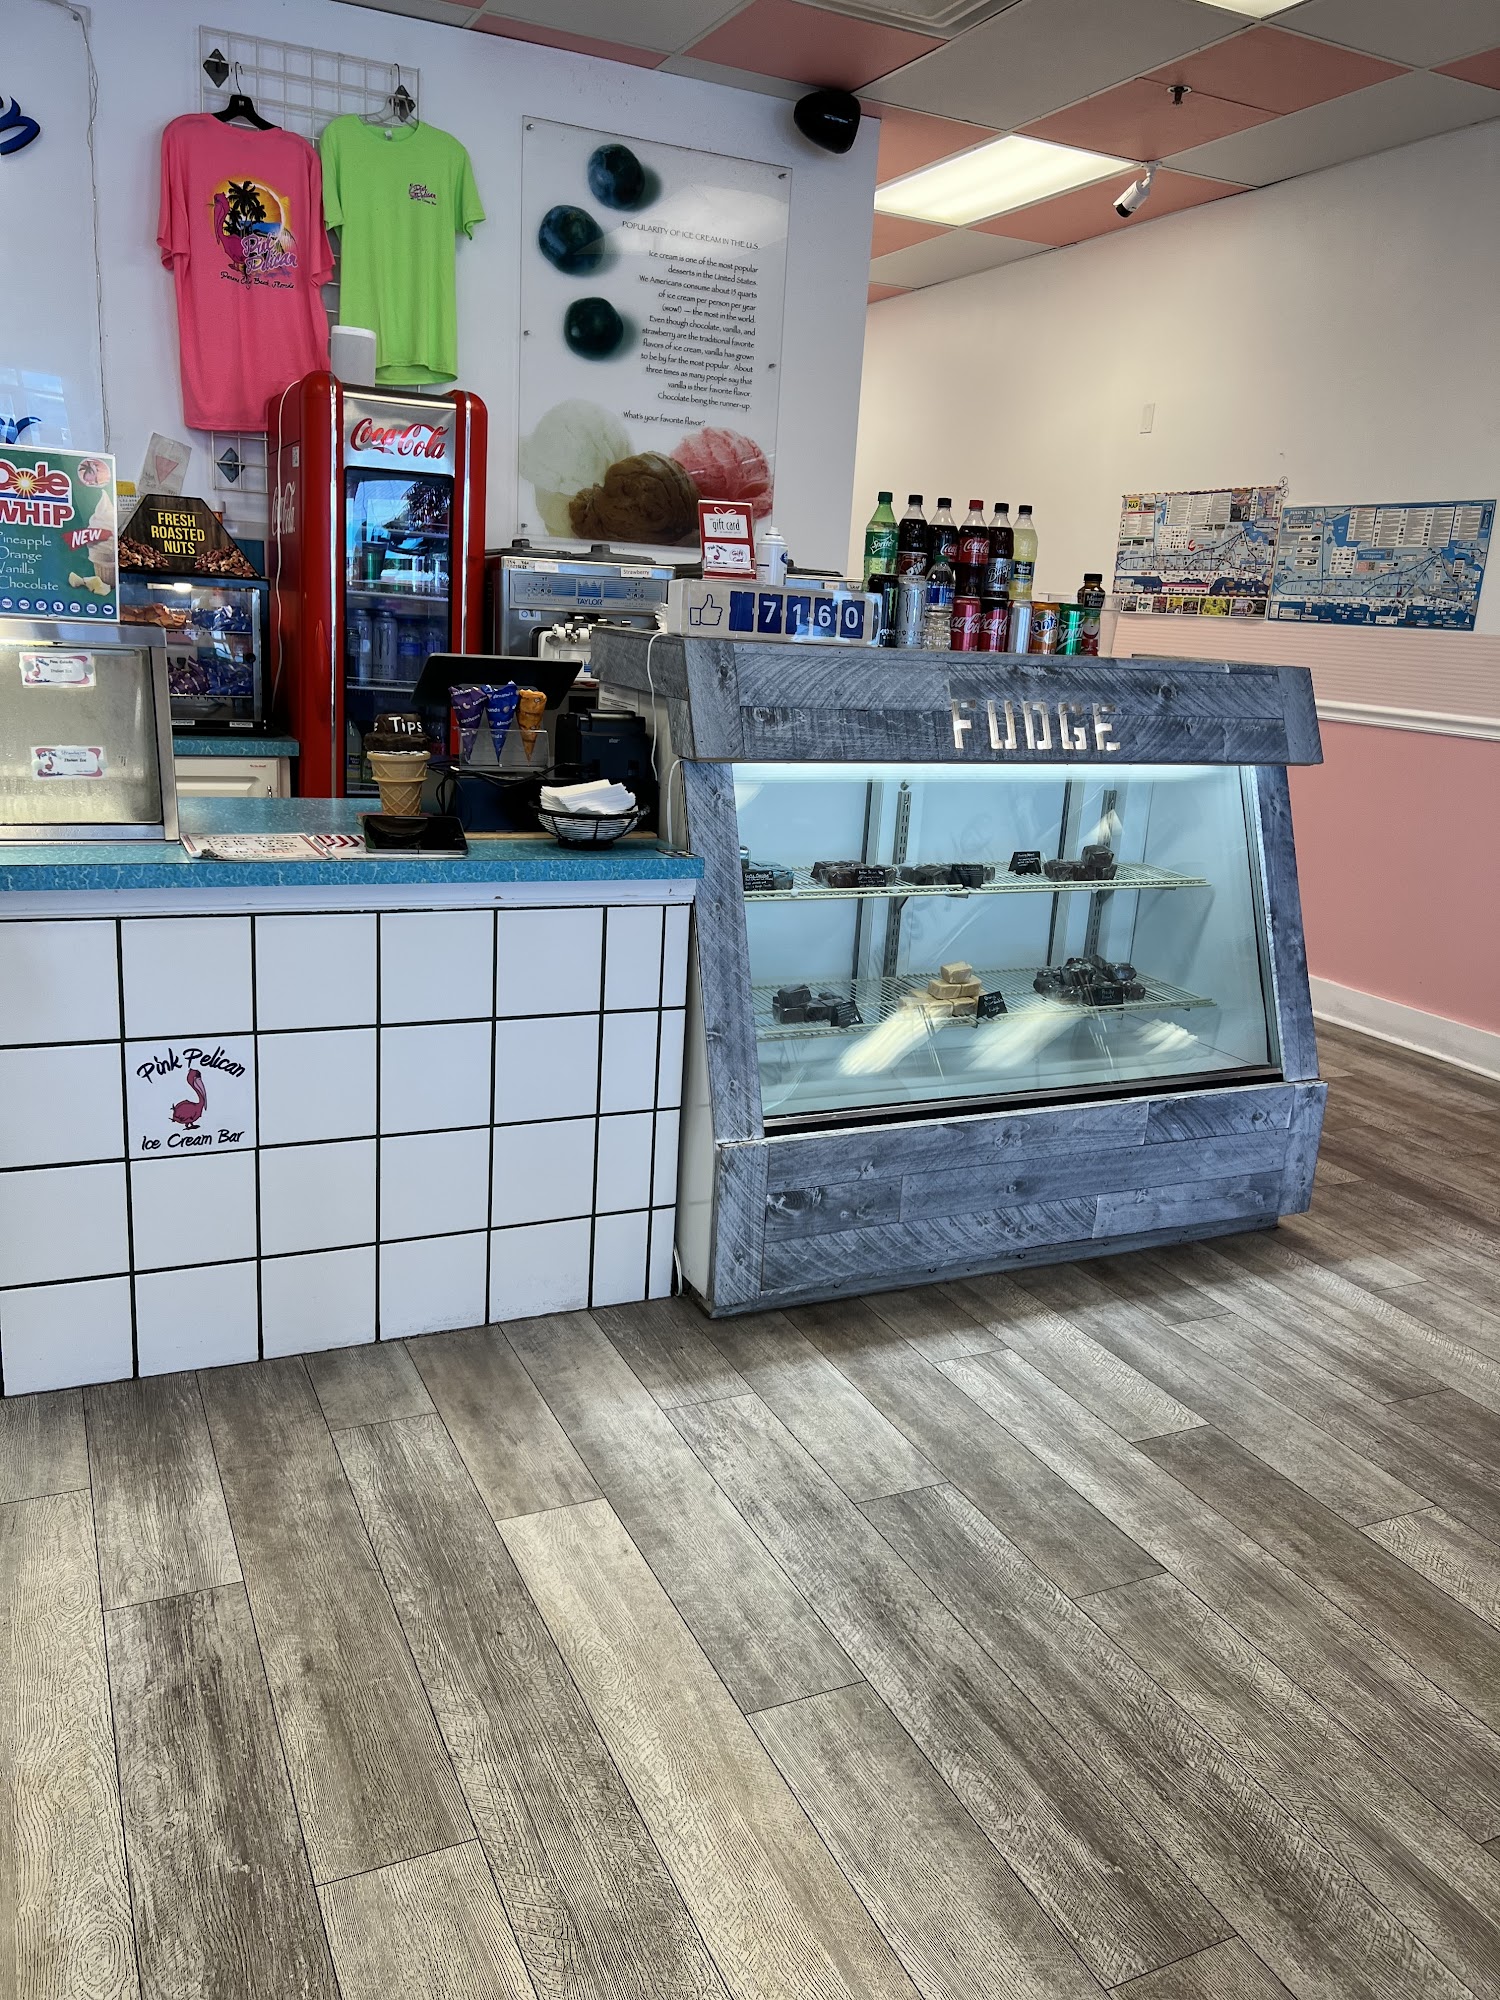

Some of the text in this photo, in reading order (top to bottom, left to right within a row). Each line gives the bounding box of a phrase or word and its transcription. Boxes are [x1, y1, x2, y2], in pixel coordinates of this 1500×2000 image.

[622, 220, 669, 236] POPULARITY
[669, 229, 681, 237] OF
[681, 231, 694, 240] ICE
[695, 233, 722, 245] CREAM
[731, 239, 746, 248] THE
[648, 250, 759, 275] Ice cream is one of the most popular
[668, 264, 696, 278] desserts
[695, 270, 702, 278] in
[702, 270, 715, 280] the
[714, 273, 736, 284] United
[638, 274, 649, 283] We
[650, 276, 683, 289] Americans
[683, 281, 711, 293] consume
[711, 284, 730, 296] about
[737, 290, 758, 301] quarts
[658, 288, 757, 313] of ice cream per person per year
[662, 303, 682, 314] (wow!)
[692, 307, 703, 316] the
[703, 310, 719, 319] most
[719, 312, 726, 320] in
[726, 312, 737, 321] the
[649, 314, 756, 337] Even though chocolate, vanilla, and
[641, 327, 755, 349] strawberry are the traditional favorite
[642, 338, 755, 362] flavors of ice cream, vanilla has grown
[640, 352, 649, 360] to
[648, 351, 657, 361] be
[658, 352, 667, 365] by
[667, 353, 678, 364] far
[678, 355, 689, 365] the
[689, 359, 705, 368] most
[733, 362, 754, 374] About
[646, 364, 663, 374] three
[663, 367, 680, 377] times
[688, 372, 706, 383] many
[706, 373, 728, 385] people
[728, 377, 740, 386] say
[740, 376, 753, 386] that
[667, 380, 687, 390] vanilla
[693, 382, 708, 393] their
[709, 384, 733, 396] favorite
[657, 391, 690, 403] Chocolate
[690, 394, 709, 407] being
[708, 396, 719, 406] the
[623, 410, 706, 427] What's your favorite flavor?
[157, 511, 196, 528] FRESH
[712, 518, 740, 533] gift card
[71, 528, 103, 549] NEW
[150, 525, 206, 542] ROASTED
[163, 540, 196, 555] NUTS
[872, 537, 893, 552] Sprite
[622, 569, 650, 577] Strawberry
[576, 597, 603, 606] TAYLOR
[1032, 615, 1058, 633] anta
[1060, 623, 1084, 641] Spri
[388, 716, 423, 736] Tips
[951, 698, 1121, 751] FUDGE
[136, 1045, 246, 1084] Pink Pelican
[141, 1128, 246, 1151] Ice Cream Bar
